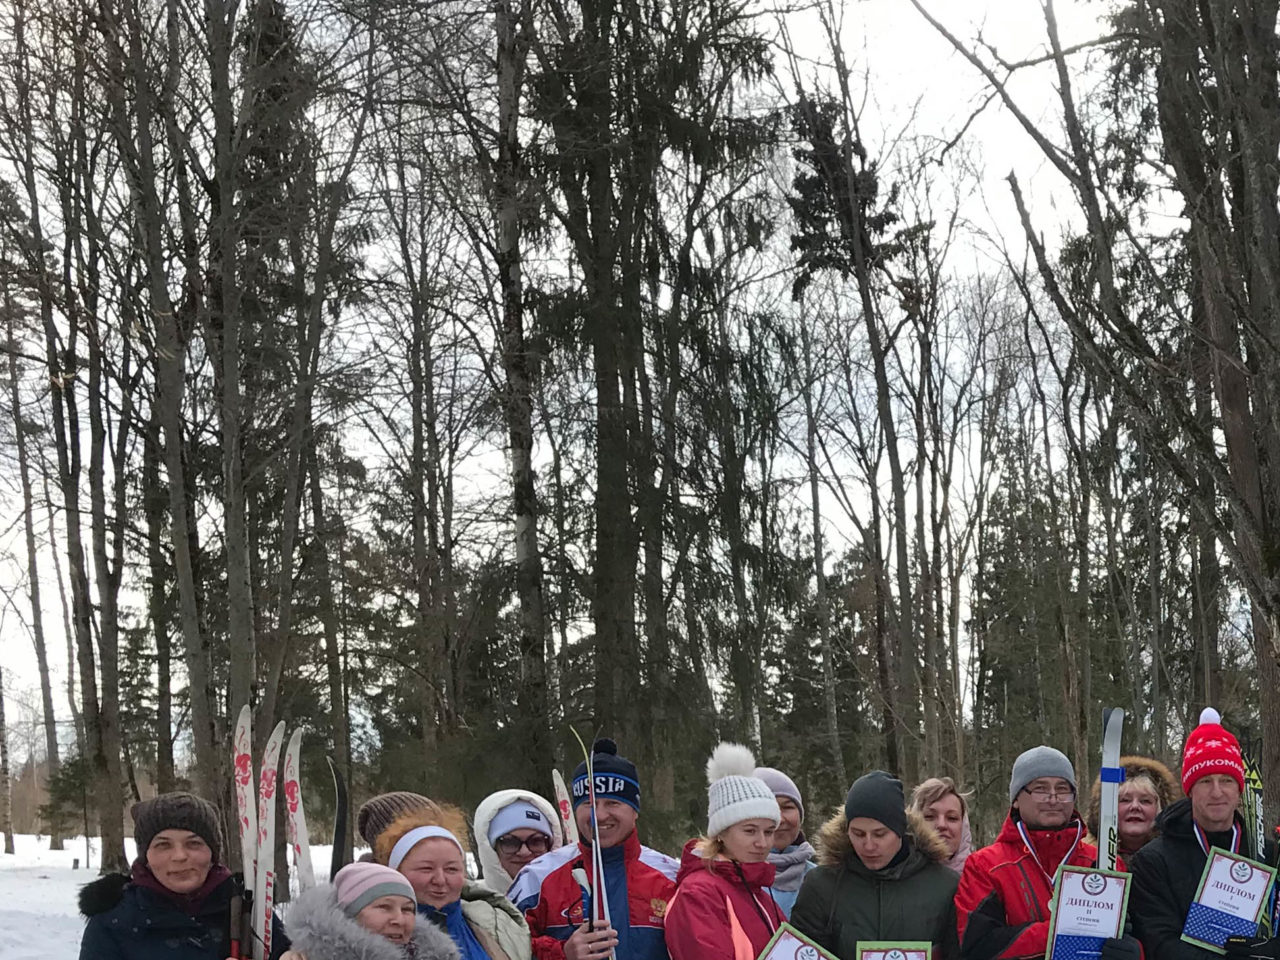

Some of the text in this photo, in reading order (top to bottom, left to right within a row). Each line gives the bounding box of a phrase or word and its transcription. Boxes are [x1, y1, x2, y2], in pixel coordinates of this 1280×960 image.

[1255, 793, 1266, 859] FISCHER
[1107, 827, 1118, 871] HER
[1066, 897, 1114, 911] ДИПЛОМ
[1211, 879, 1256, 901] ДИПЛОМ
